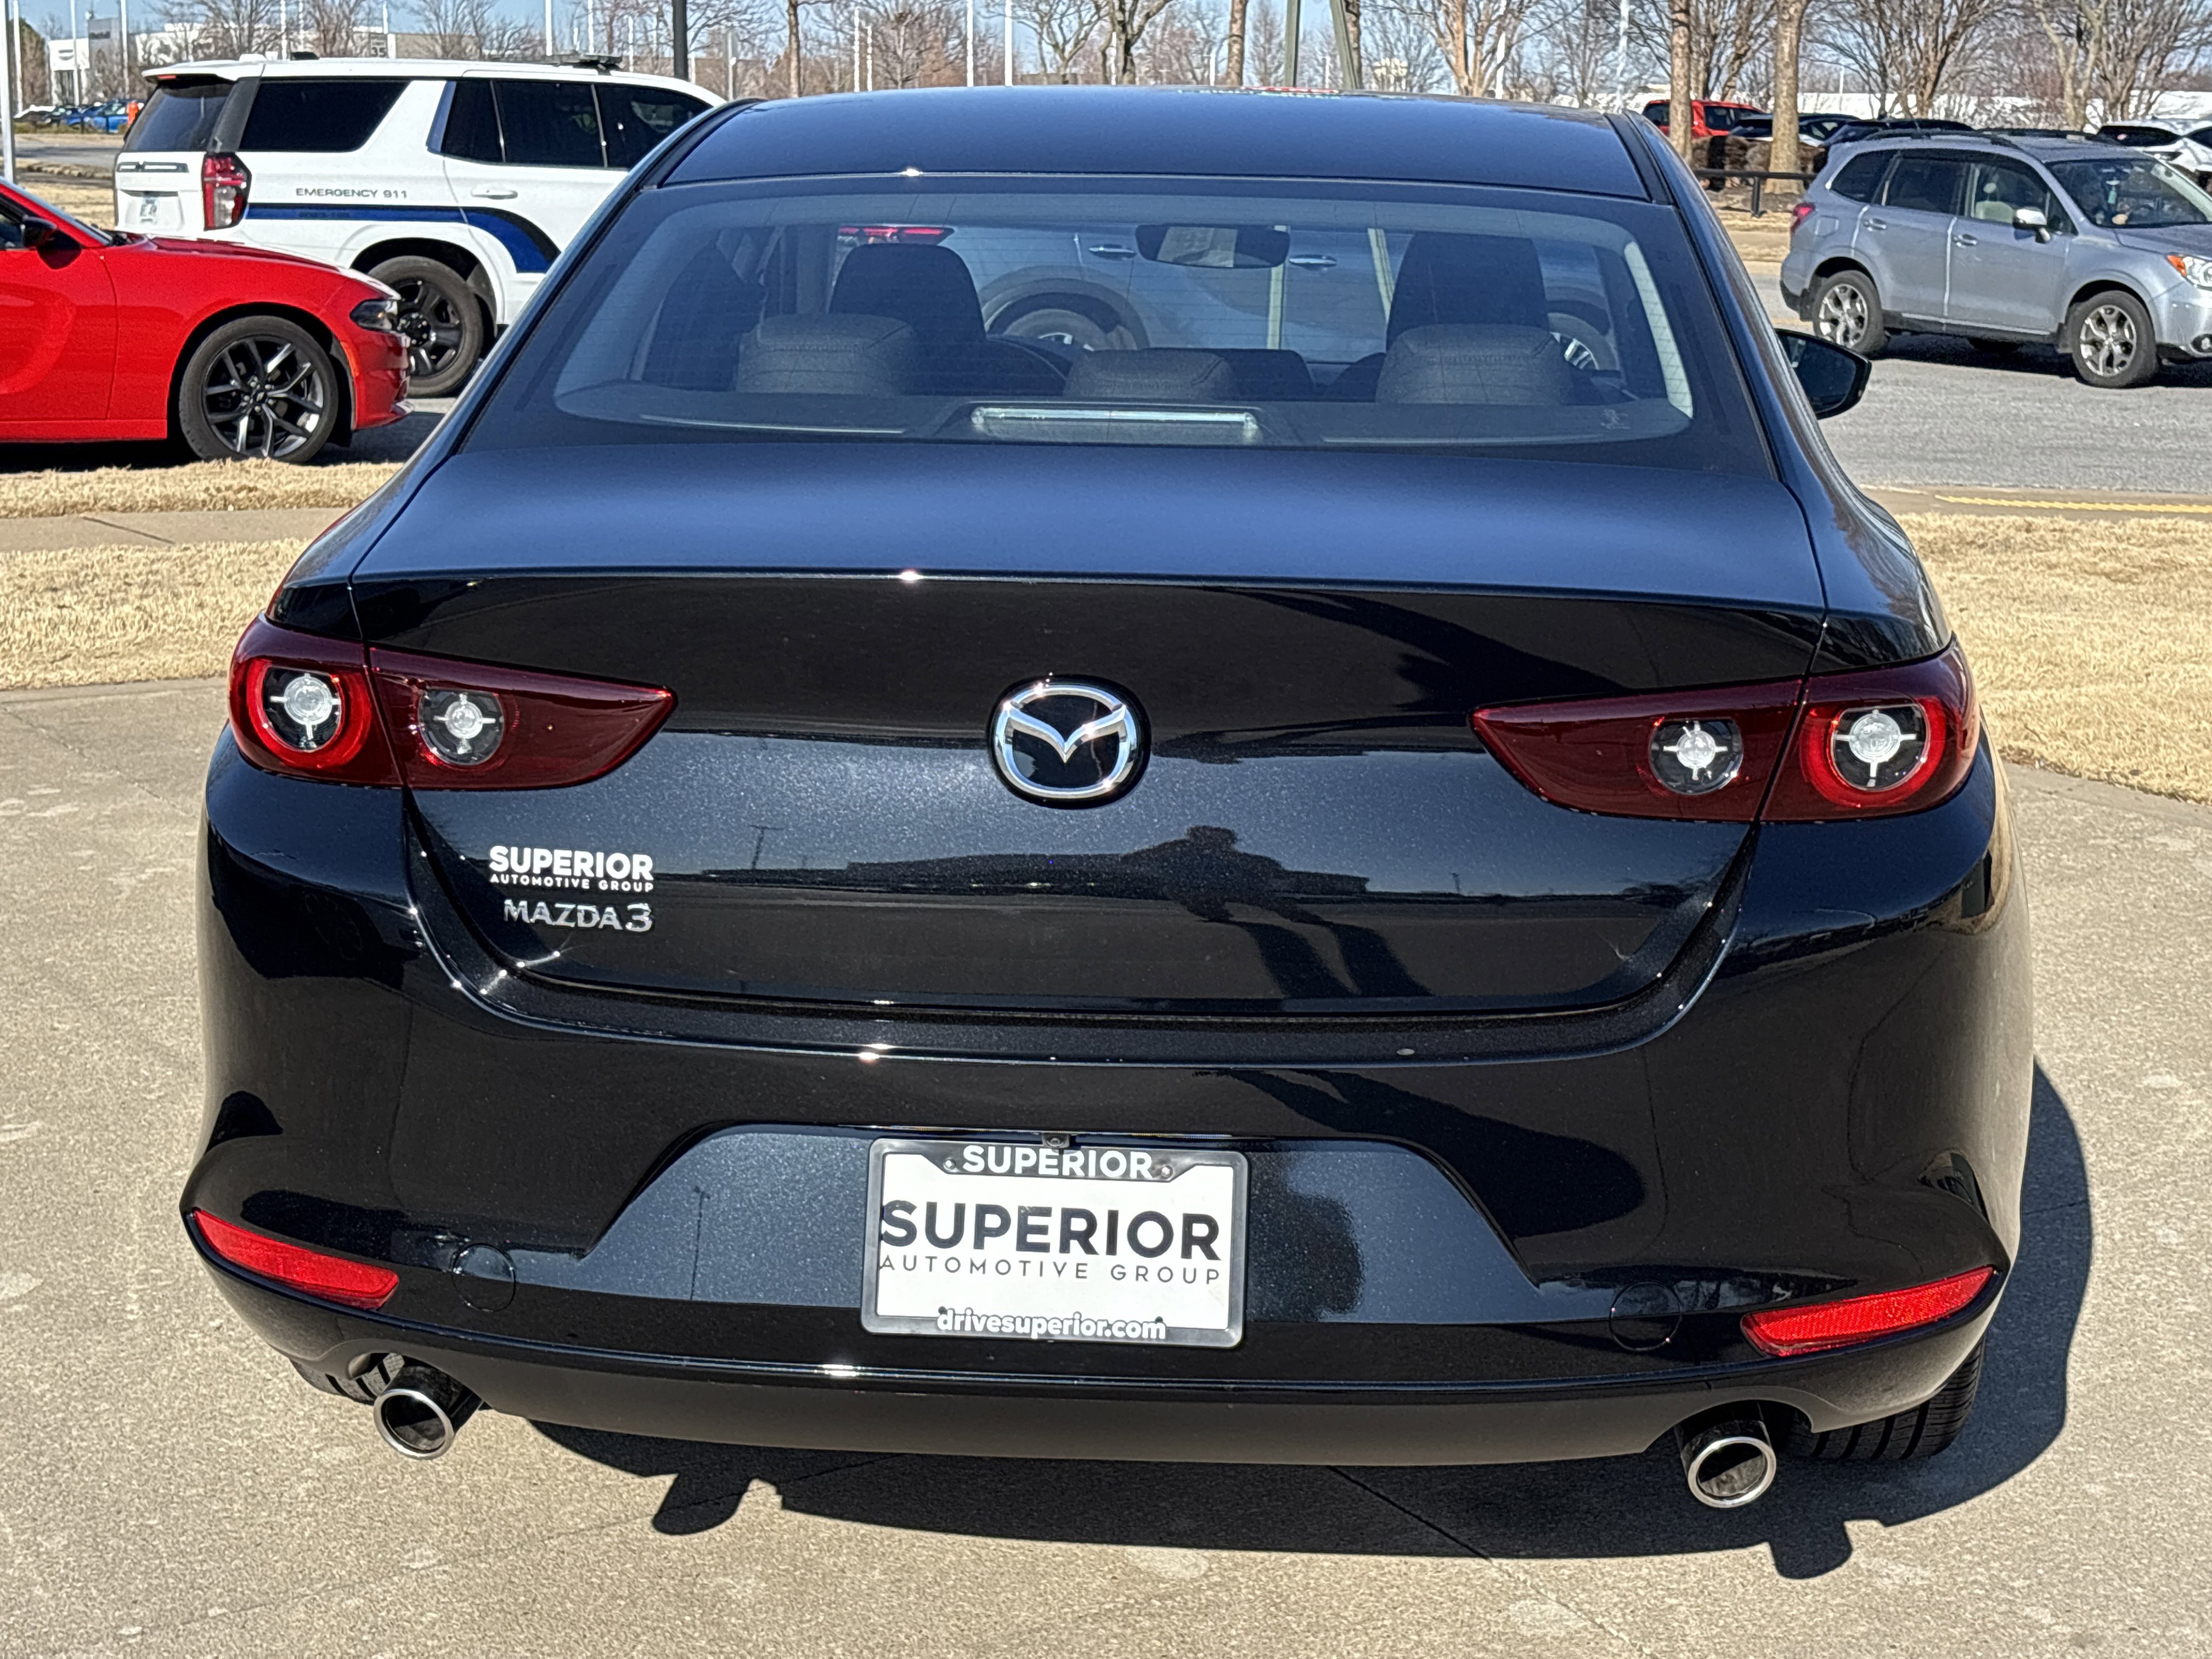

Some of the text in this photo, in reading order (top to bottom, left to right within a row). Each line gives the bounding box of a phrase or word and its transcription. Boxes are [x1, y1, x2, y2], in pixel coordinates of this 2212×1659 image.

[371, 47, 387, 57] 35
[296, 188, 407, 198] EMERGENCY 911
[489, 845, 654, 881] SUPERIOR
[489, 874, 654, 893] AUTOMOTIVE GROUP
[963, 1146, 1153, 1179] SUPERIOR
[881, 1199, 1222, 1261] SUPERIOR
[879, 1254, 1220, 1285] AUTOMOTIVE GROUP
[938, 1307, 1166, 1340] drivesuperior.com
